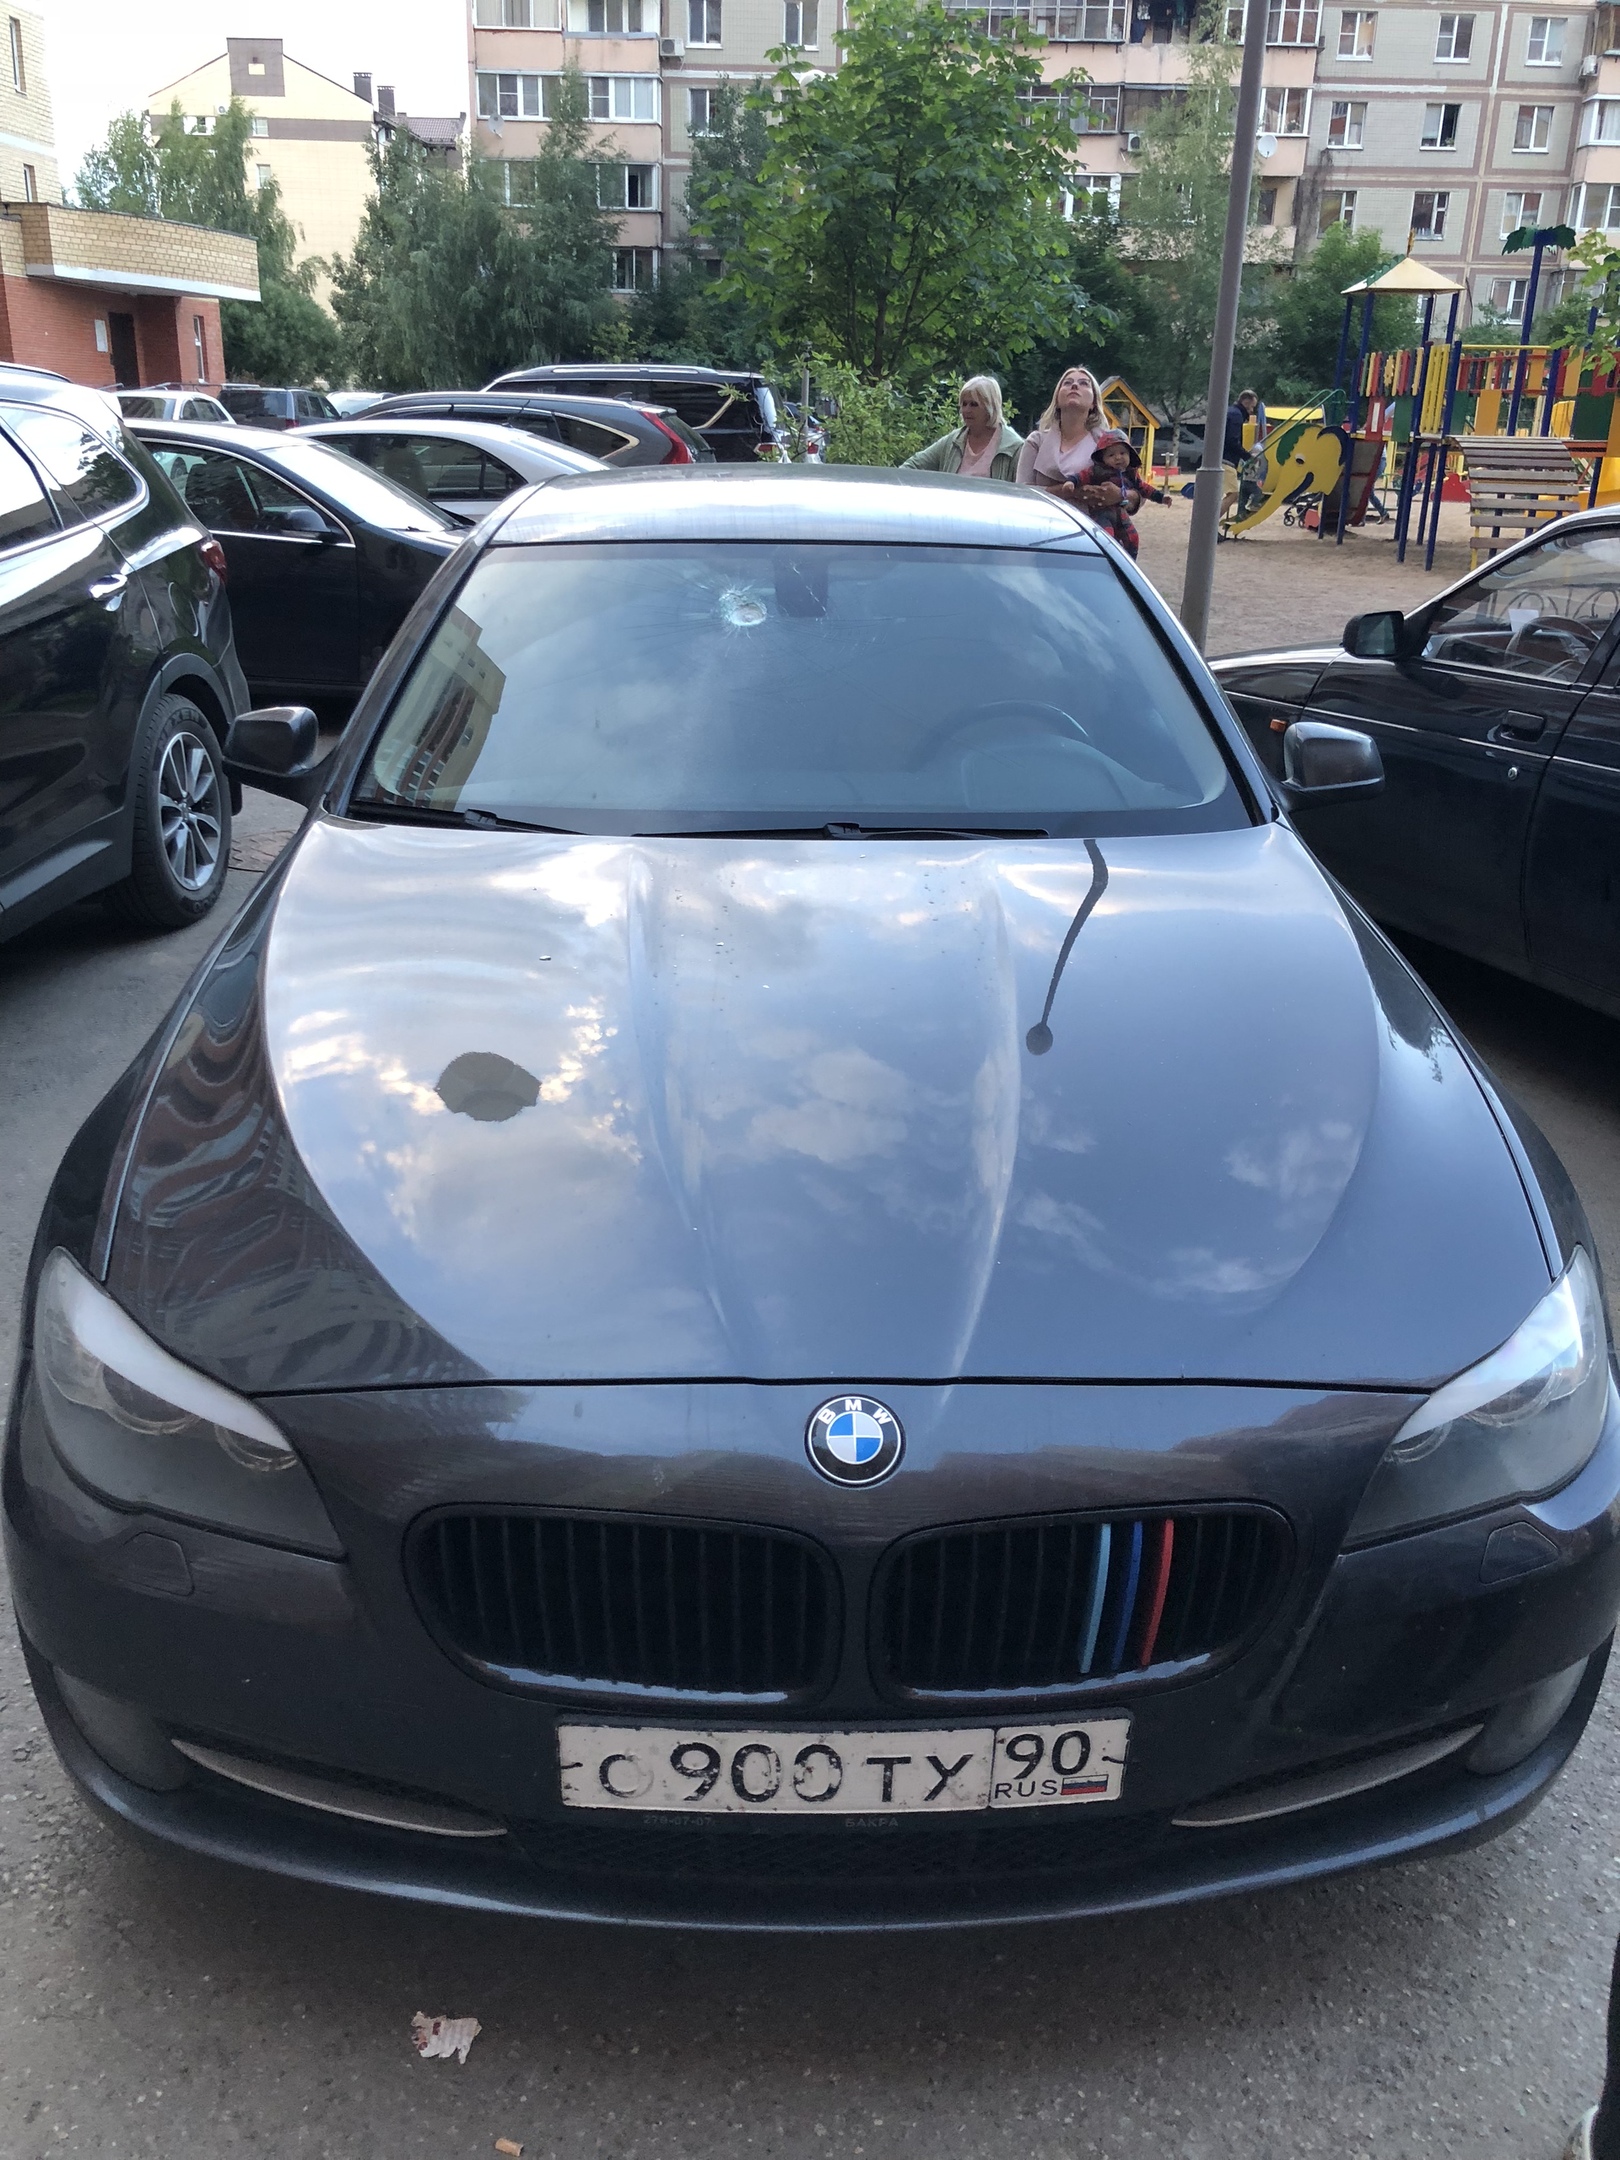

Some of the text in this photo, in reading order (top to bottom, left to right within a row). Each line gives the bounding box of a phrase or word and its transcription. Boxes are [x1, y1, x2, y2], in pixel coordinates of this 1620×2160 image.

[817, 1398, 892, 1425] BMW
[1005, 1730, 1091, 1780] 90
[994, 1780, 1058, 1799] RUS
